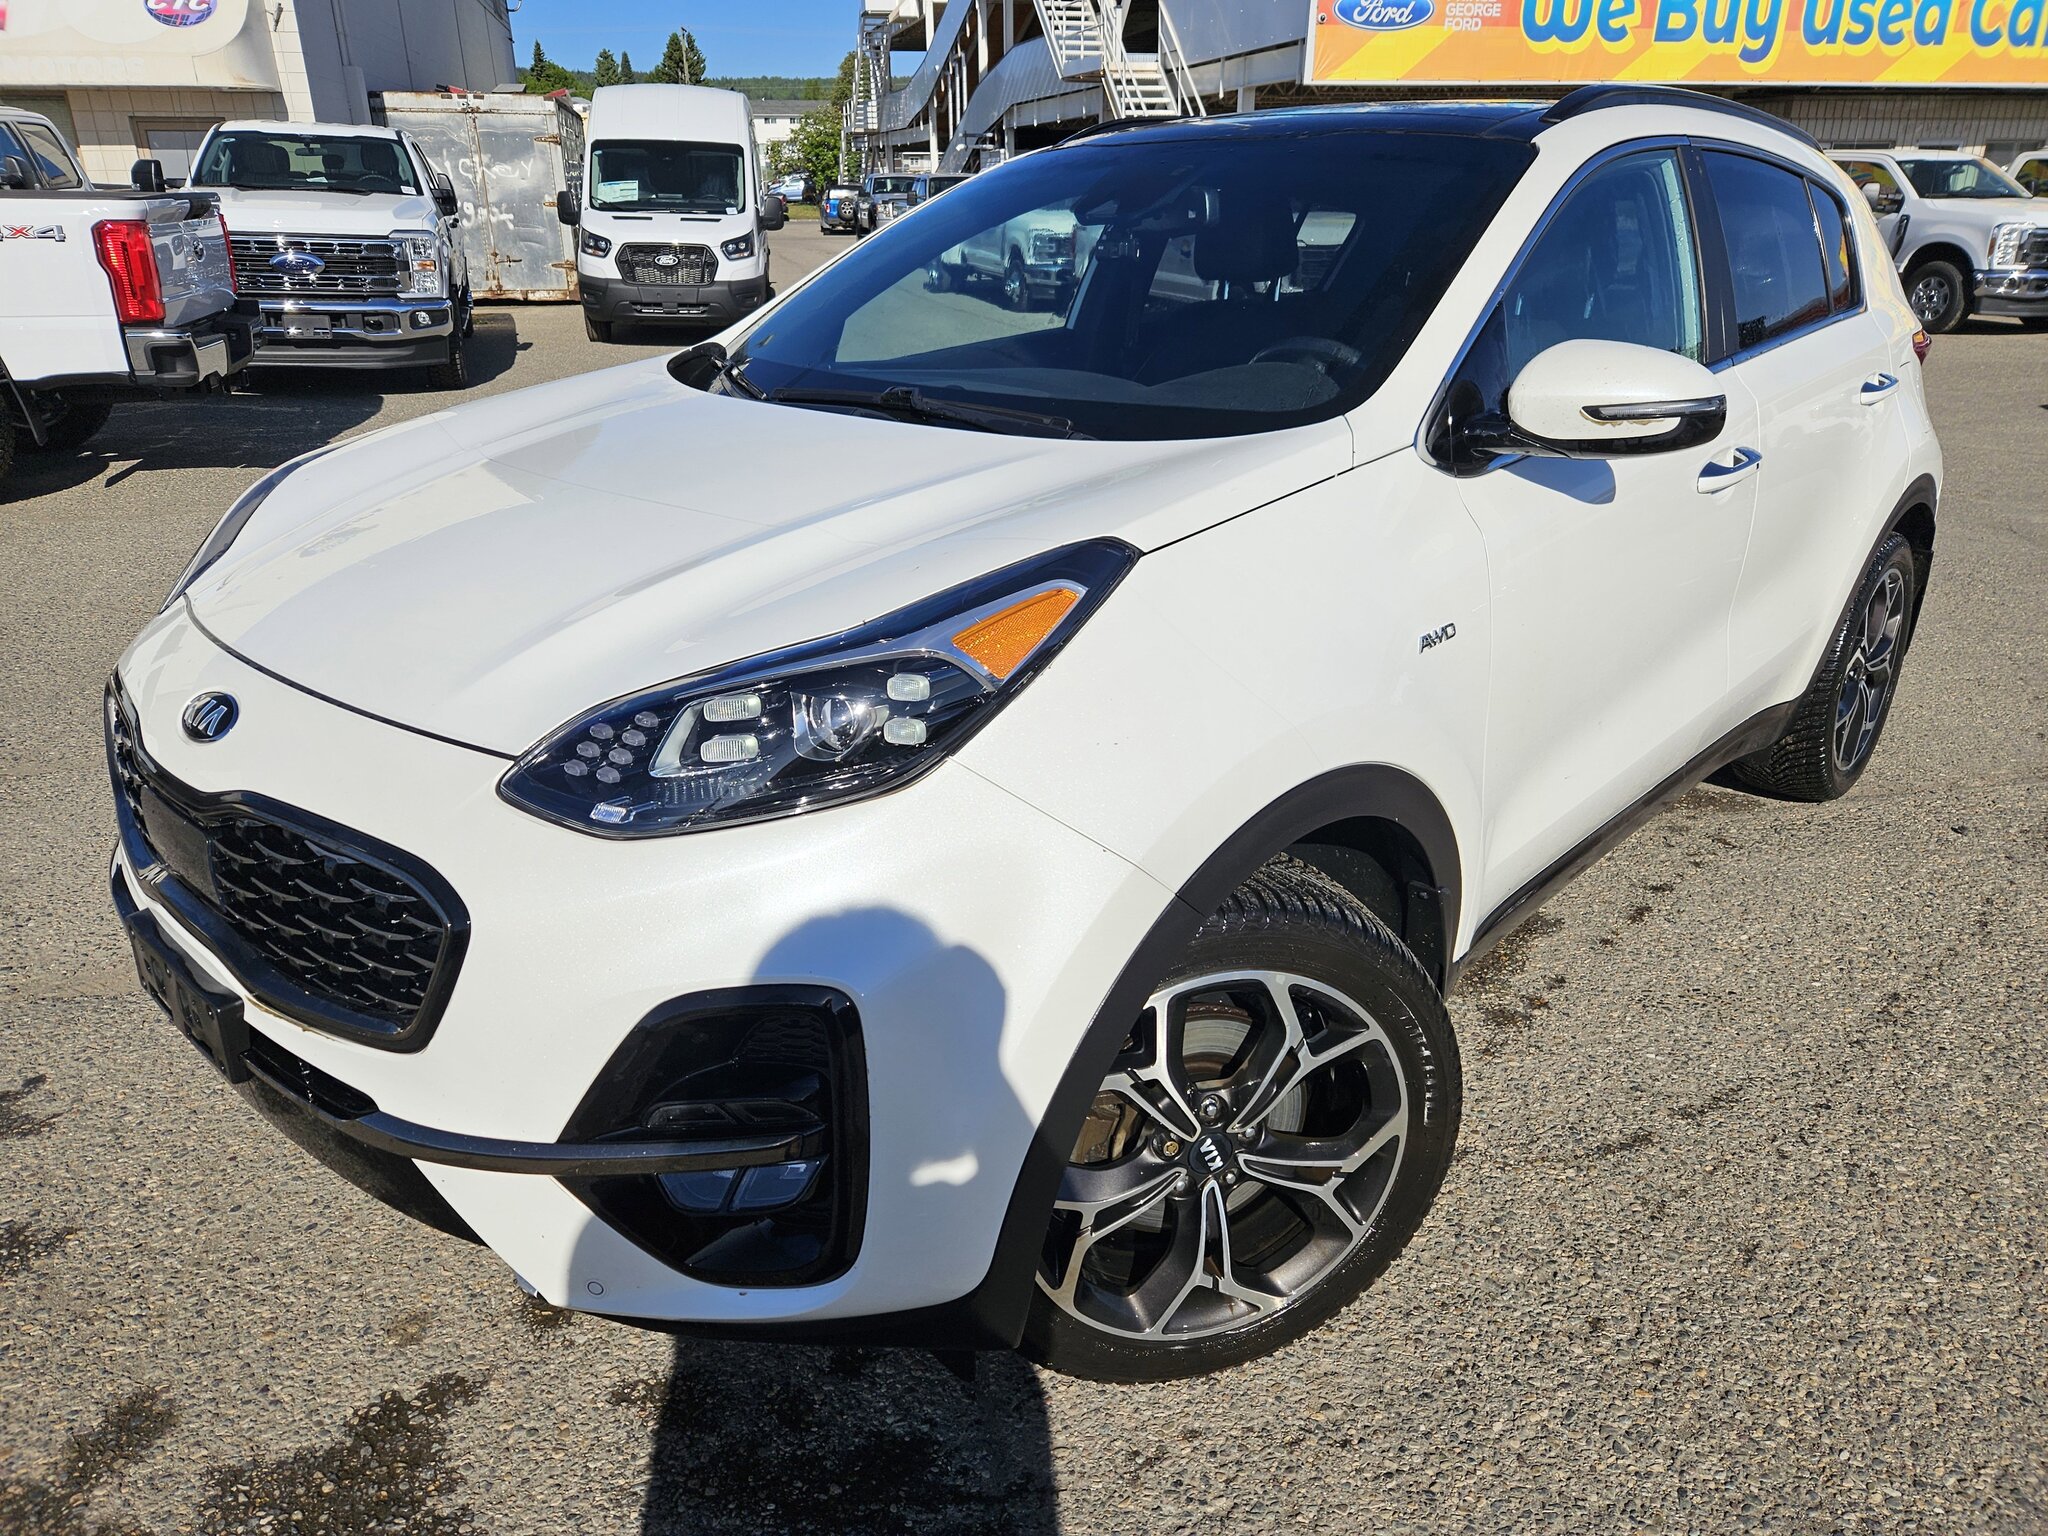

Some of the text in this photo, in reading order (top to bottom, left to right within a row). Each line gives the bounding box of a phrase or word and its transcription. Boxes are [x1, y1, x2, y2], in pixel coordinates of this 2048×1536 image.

[1353, 0, 1427, 24] Ford
[1445, 3, 1502, 17] GEORGE
[1443, 17, 1482, 32] FORD
[1521, 0, 1637, 44] We
[1653, 0, 1784, 64] Buy
[1969, 0, 2048, 48] Ca
[0, 224, 66, 242] X4
[1418, 622, 1457, 655] AWD
[1199, 1137, 1224, 1171] KIA
